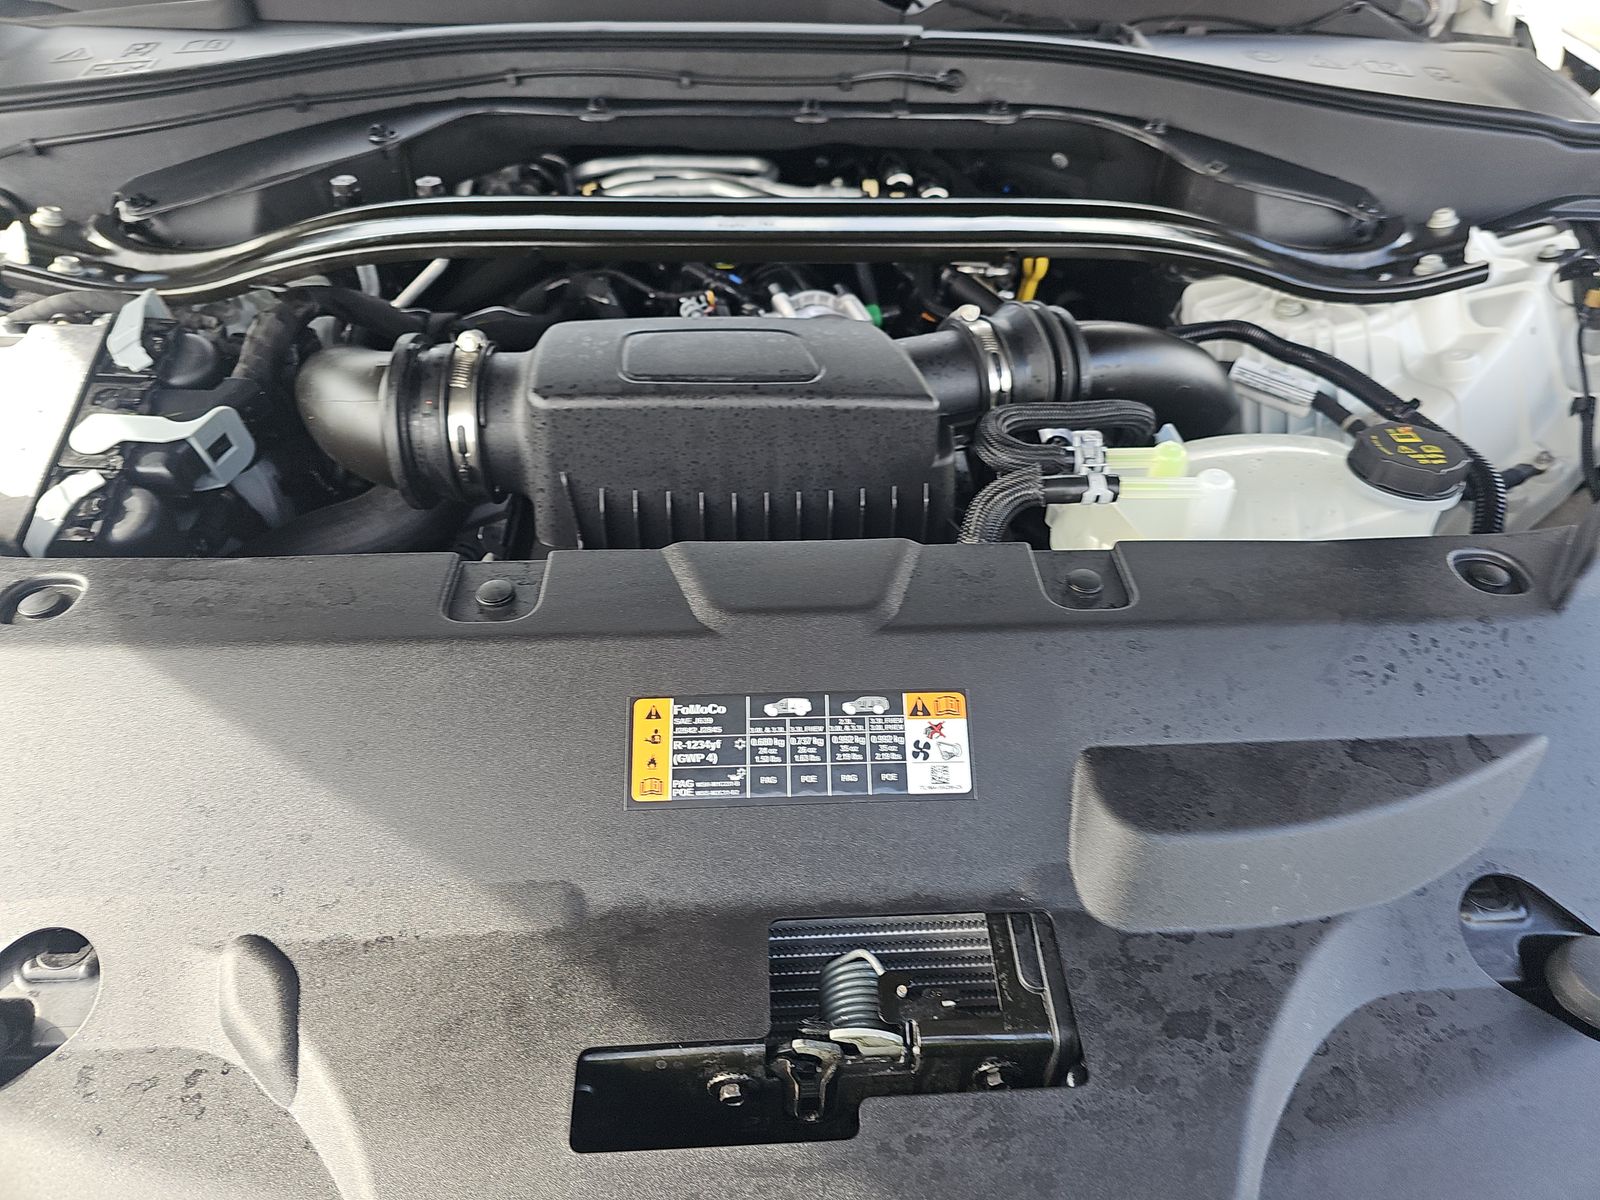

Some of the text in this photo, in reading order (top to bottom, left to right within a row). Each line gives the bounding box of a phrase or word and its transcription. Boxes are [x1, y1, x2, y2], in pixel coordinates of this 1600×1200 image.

[673, 703, 727, 715] FoMoCo
[673, 739, 723, 751] R-1234yf
[773, 737, 785, 747] kg
[812, 737, 824, 747] kg
[854, 735, 866, 745] kg
[893, 735, 905, 745] kg
[673, 752, 719, 766] (GWP 4)
[759, 775, 778, 784] PAG
[840, 773, 859, 783] PAG
[672, 779, 695, 788] PAG
[672, 788, 695, 797] POE
